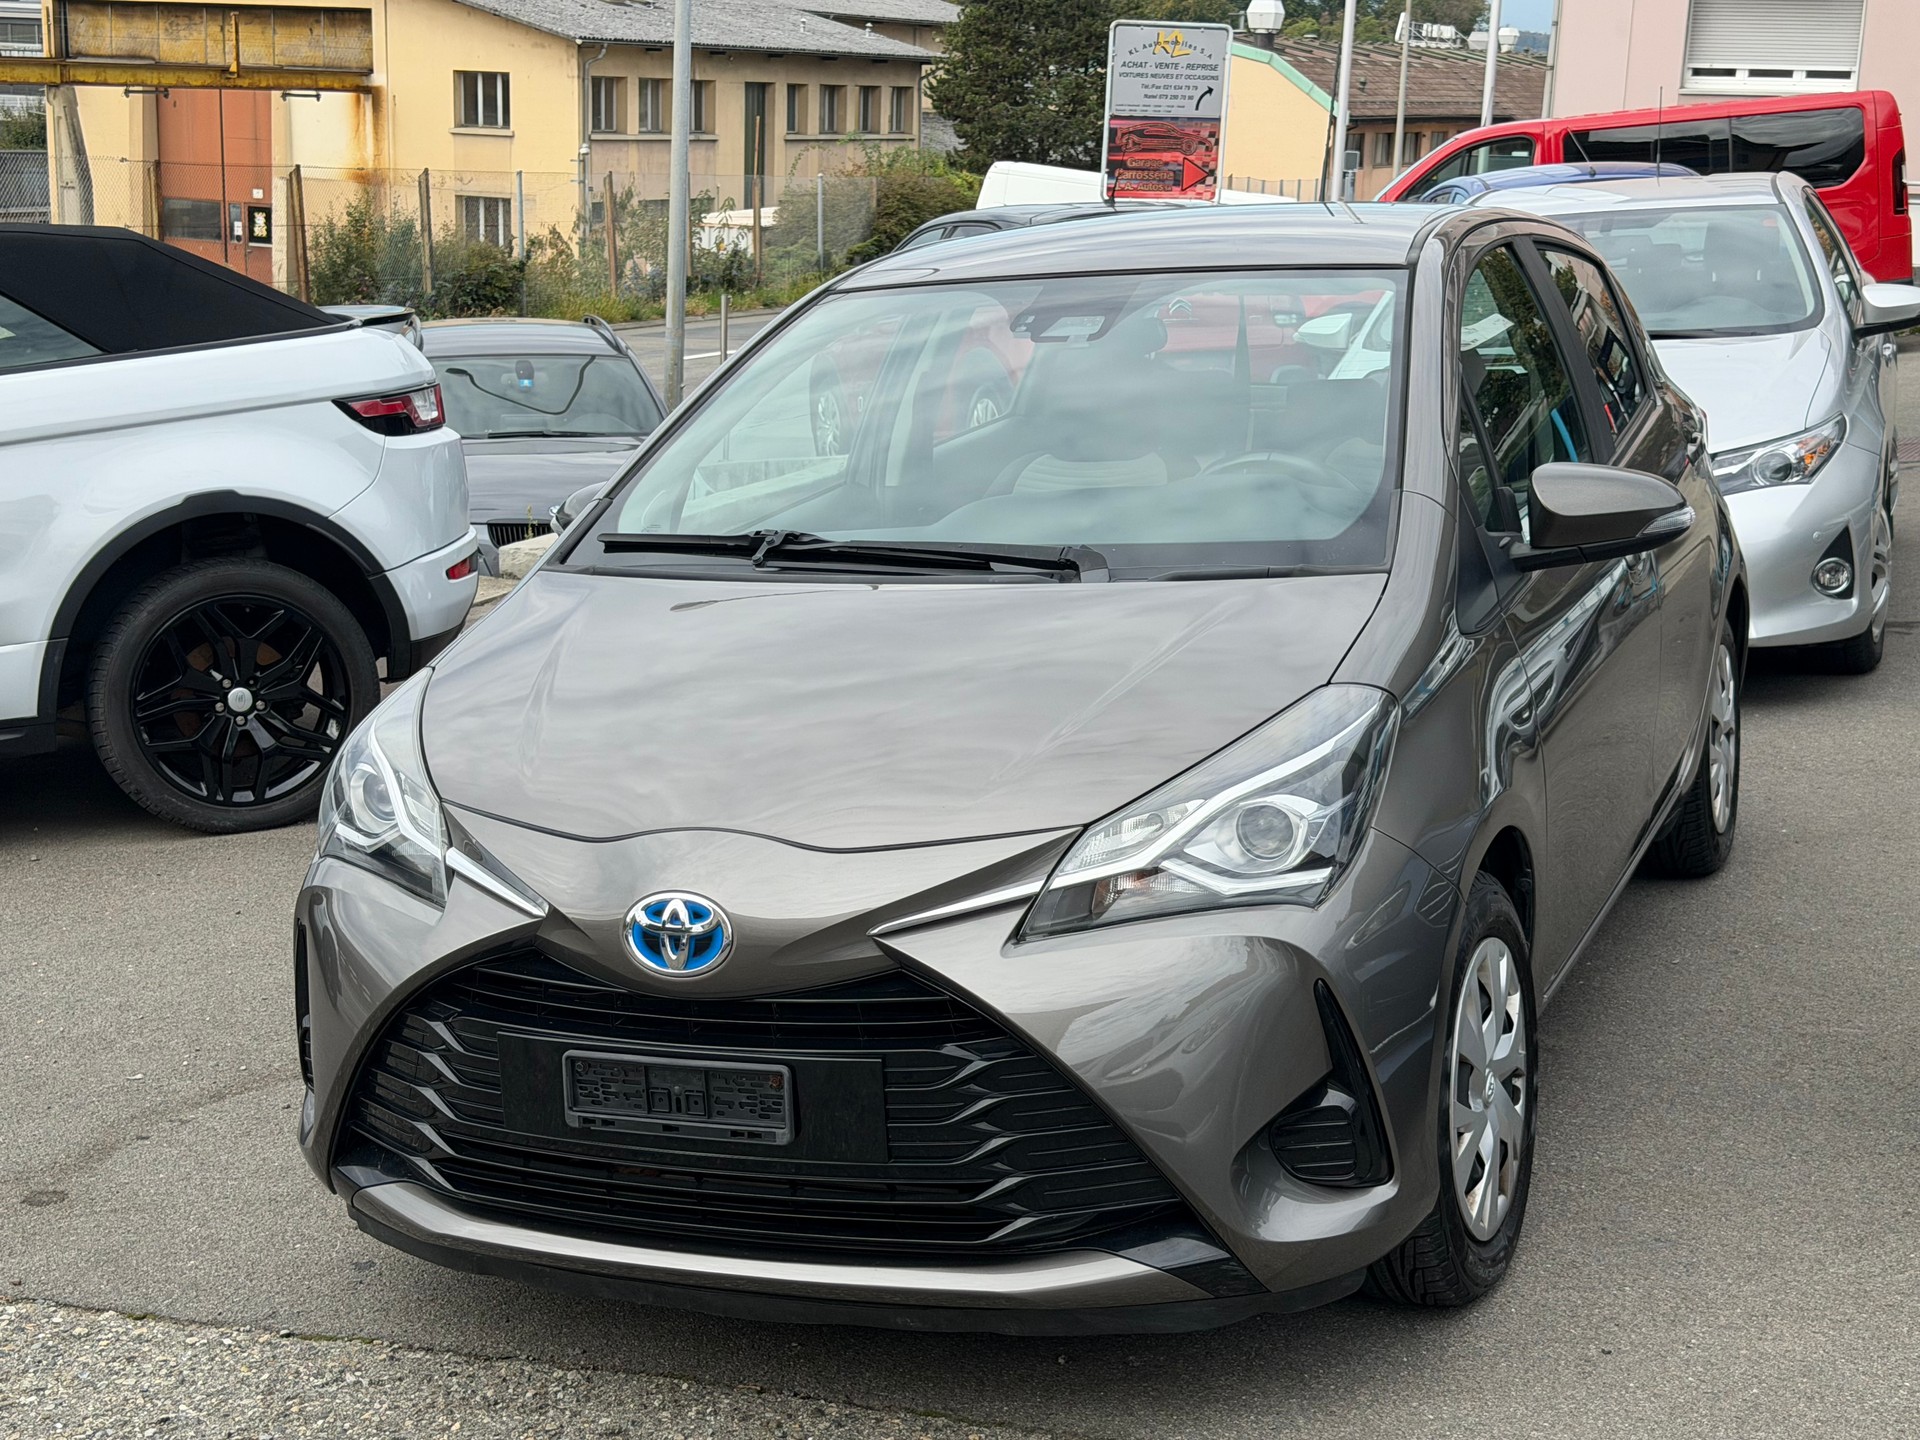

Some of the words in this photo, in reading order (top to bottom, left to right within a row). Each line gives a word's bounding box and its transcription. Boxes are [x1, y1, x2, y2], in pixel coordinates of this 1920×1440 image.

[1128, 47, 1139, 56] KL
[1142, 40, 1197, 51] Automobiles
[1154, 62, 1180, 70] VENTE
[1185, 63, 1219, 71] REPRISE
[1127, 157, 1163, 168] Garage
[1115, 168, 1174, 180] Carrosserie
[1138, 182, 1164, 190] Autos
